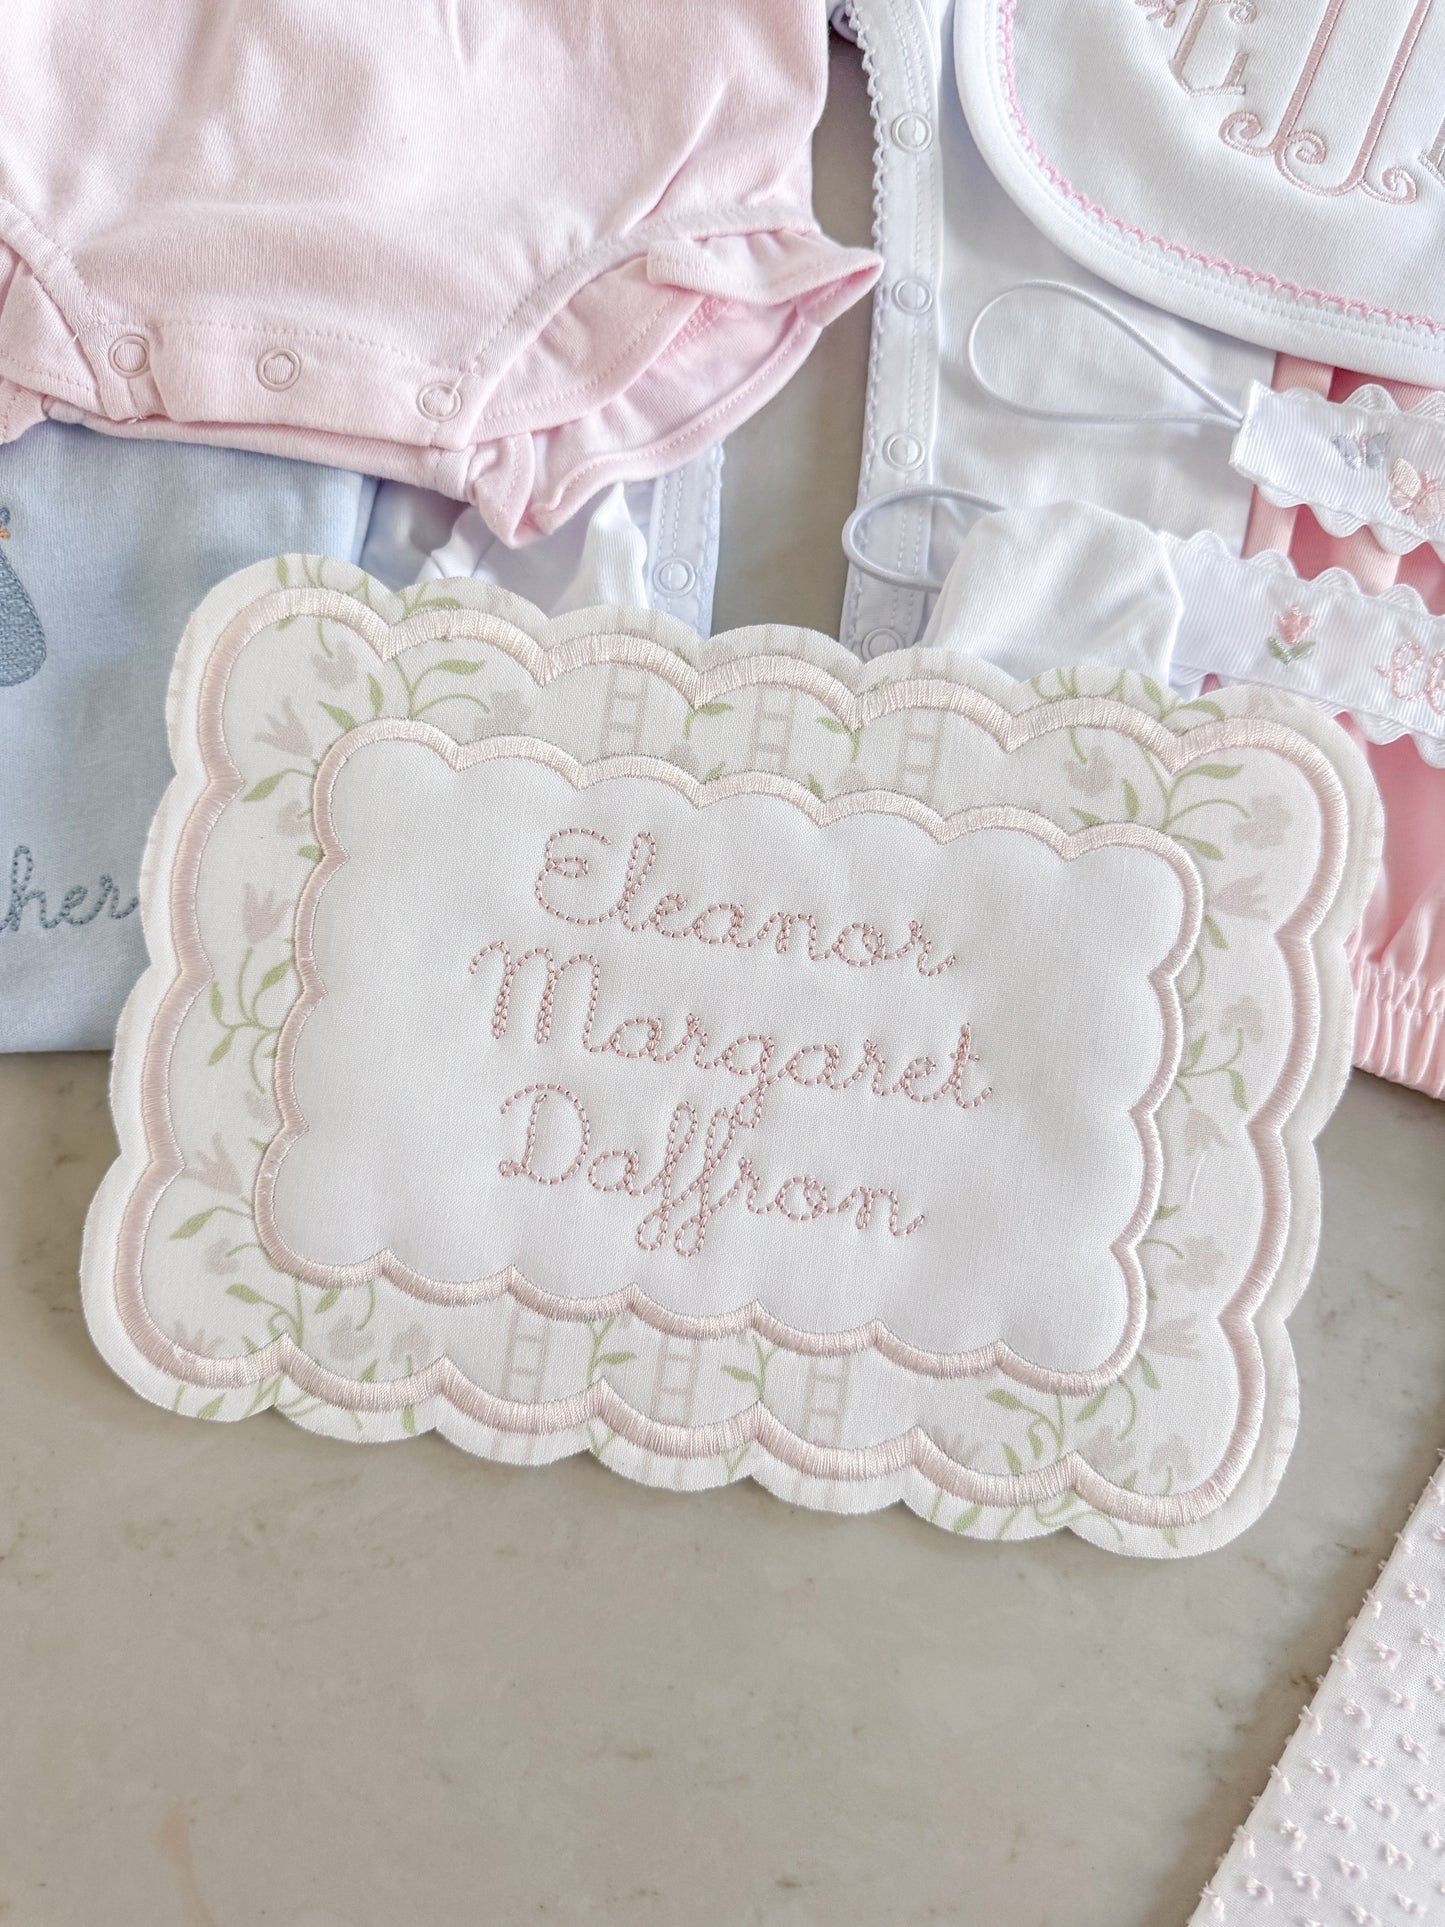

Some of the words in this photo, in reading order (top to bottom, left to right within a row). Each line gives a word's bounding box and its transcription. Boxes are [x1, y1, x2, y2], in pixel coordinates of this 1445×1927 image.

[0, 845, 139, 932] her
[535, 828, 957, 976] Eleanor
[469, 940, 993, 1128] Margaret
[499, 1083, 926, 1257] Daffron
